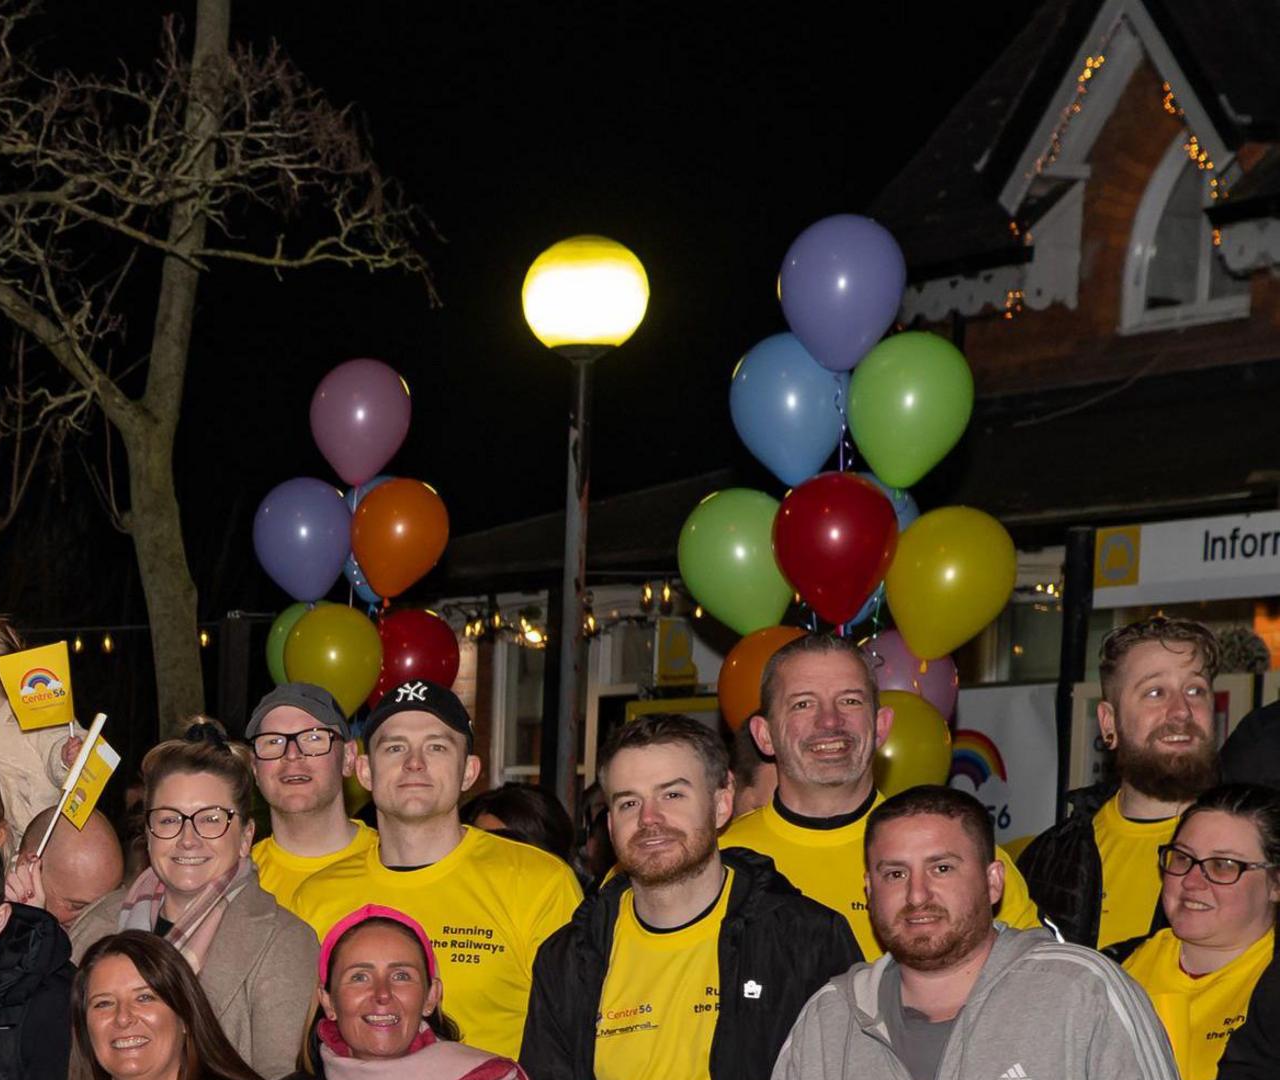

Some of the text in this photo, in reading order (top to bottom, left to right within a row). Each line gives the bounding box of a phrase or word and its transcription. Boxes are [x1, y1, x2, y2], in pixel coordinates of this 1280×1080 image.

[21, 688, 66, 704] Centre 56
[442, 925, 493, 939] Running
[450, 939, 505, 954] Railways
[450, 953, 480, 965] 2025
[639, 1004, 653, 1015] 56
[693, 1003, 712, 1013] the
